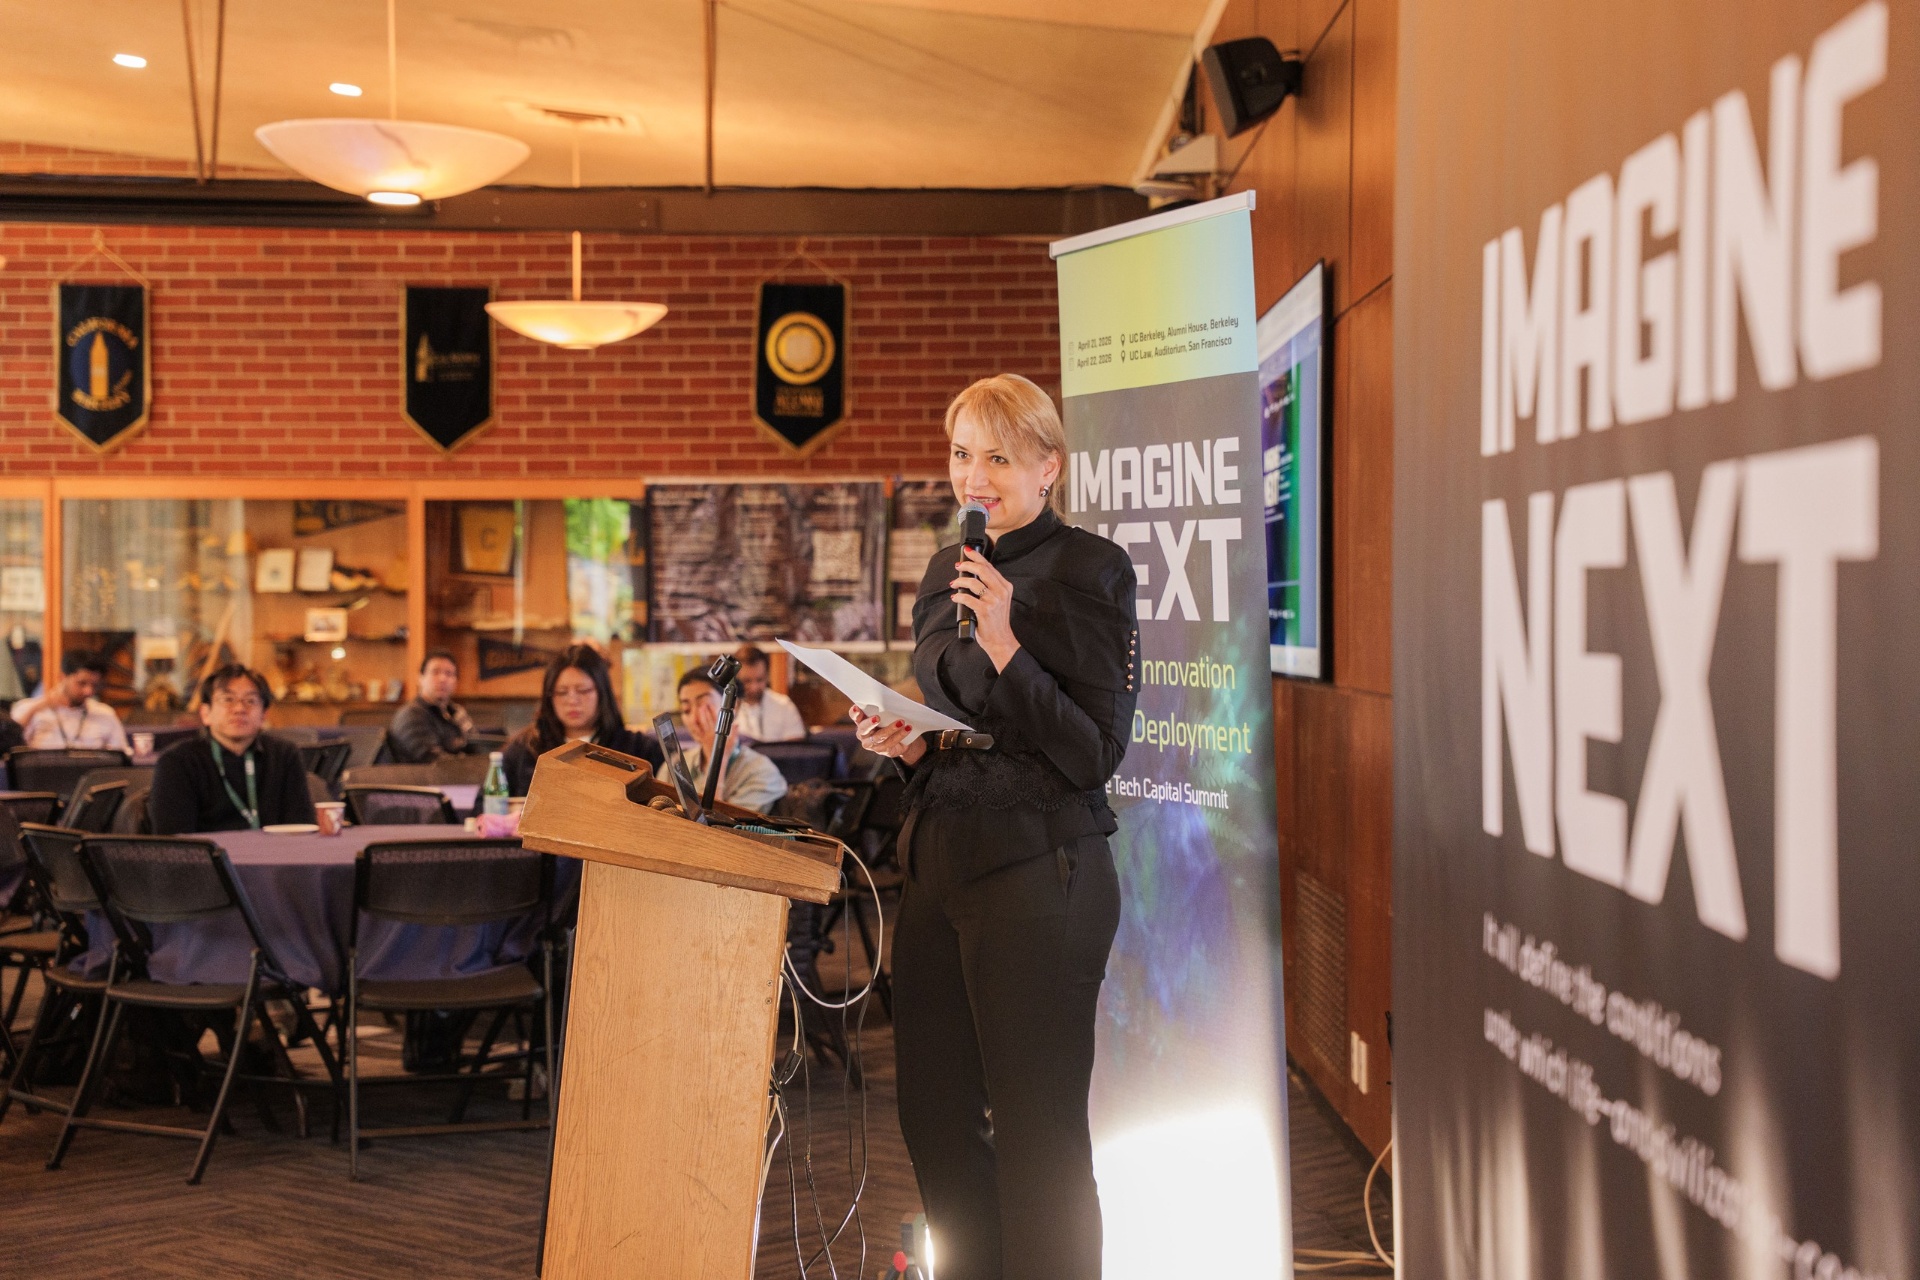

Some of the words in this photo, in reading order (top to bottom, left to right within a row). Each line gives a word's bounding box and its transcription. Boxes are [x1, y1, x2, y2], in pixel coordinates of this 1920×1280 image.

[1480, 0, 1889, 457] IMAGINE
[1077, 340, 1090, 351] April
[1129, 333, 1139, 344] UC
[1140, 328, 1165, 342] Berkeley,
[1167, 325, 1187, 337] Alumni
[1188, 322, 1208, 333] House,
[1210, 316, 1239, 329] Berkeley
[1077, 358, 1089, 368] April
[1129, 350, 1139, 361] UC
[1140, 349, 1154, 360] Law,
[1155, 344, 1187, 357] Auditorium,
[1188, 341, 1200, 351] San
[1201, 337, 1232, 349] Francisco
[1070, 437, 1242, 513] IMAGINE
[1072, 518, 1242, 622] EXT
[1141, 656, 1236, 690] nnovation
[1482, 434, 1879, 981] NEXT
[1132, 709, 1252, 756] Deployment
[1113, 774, 1141, 797] Tech
[1143, 778, 1182, 804] Capital
[1184, 783, 1229, 809] Summit
